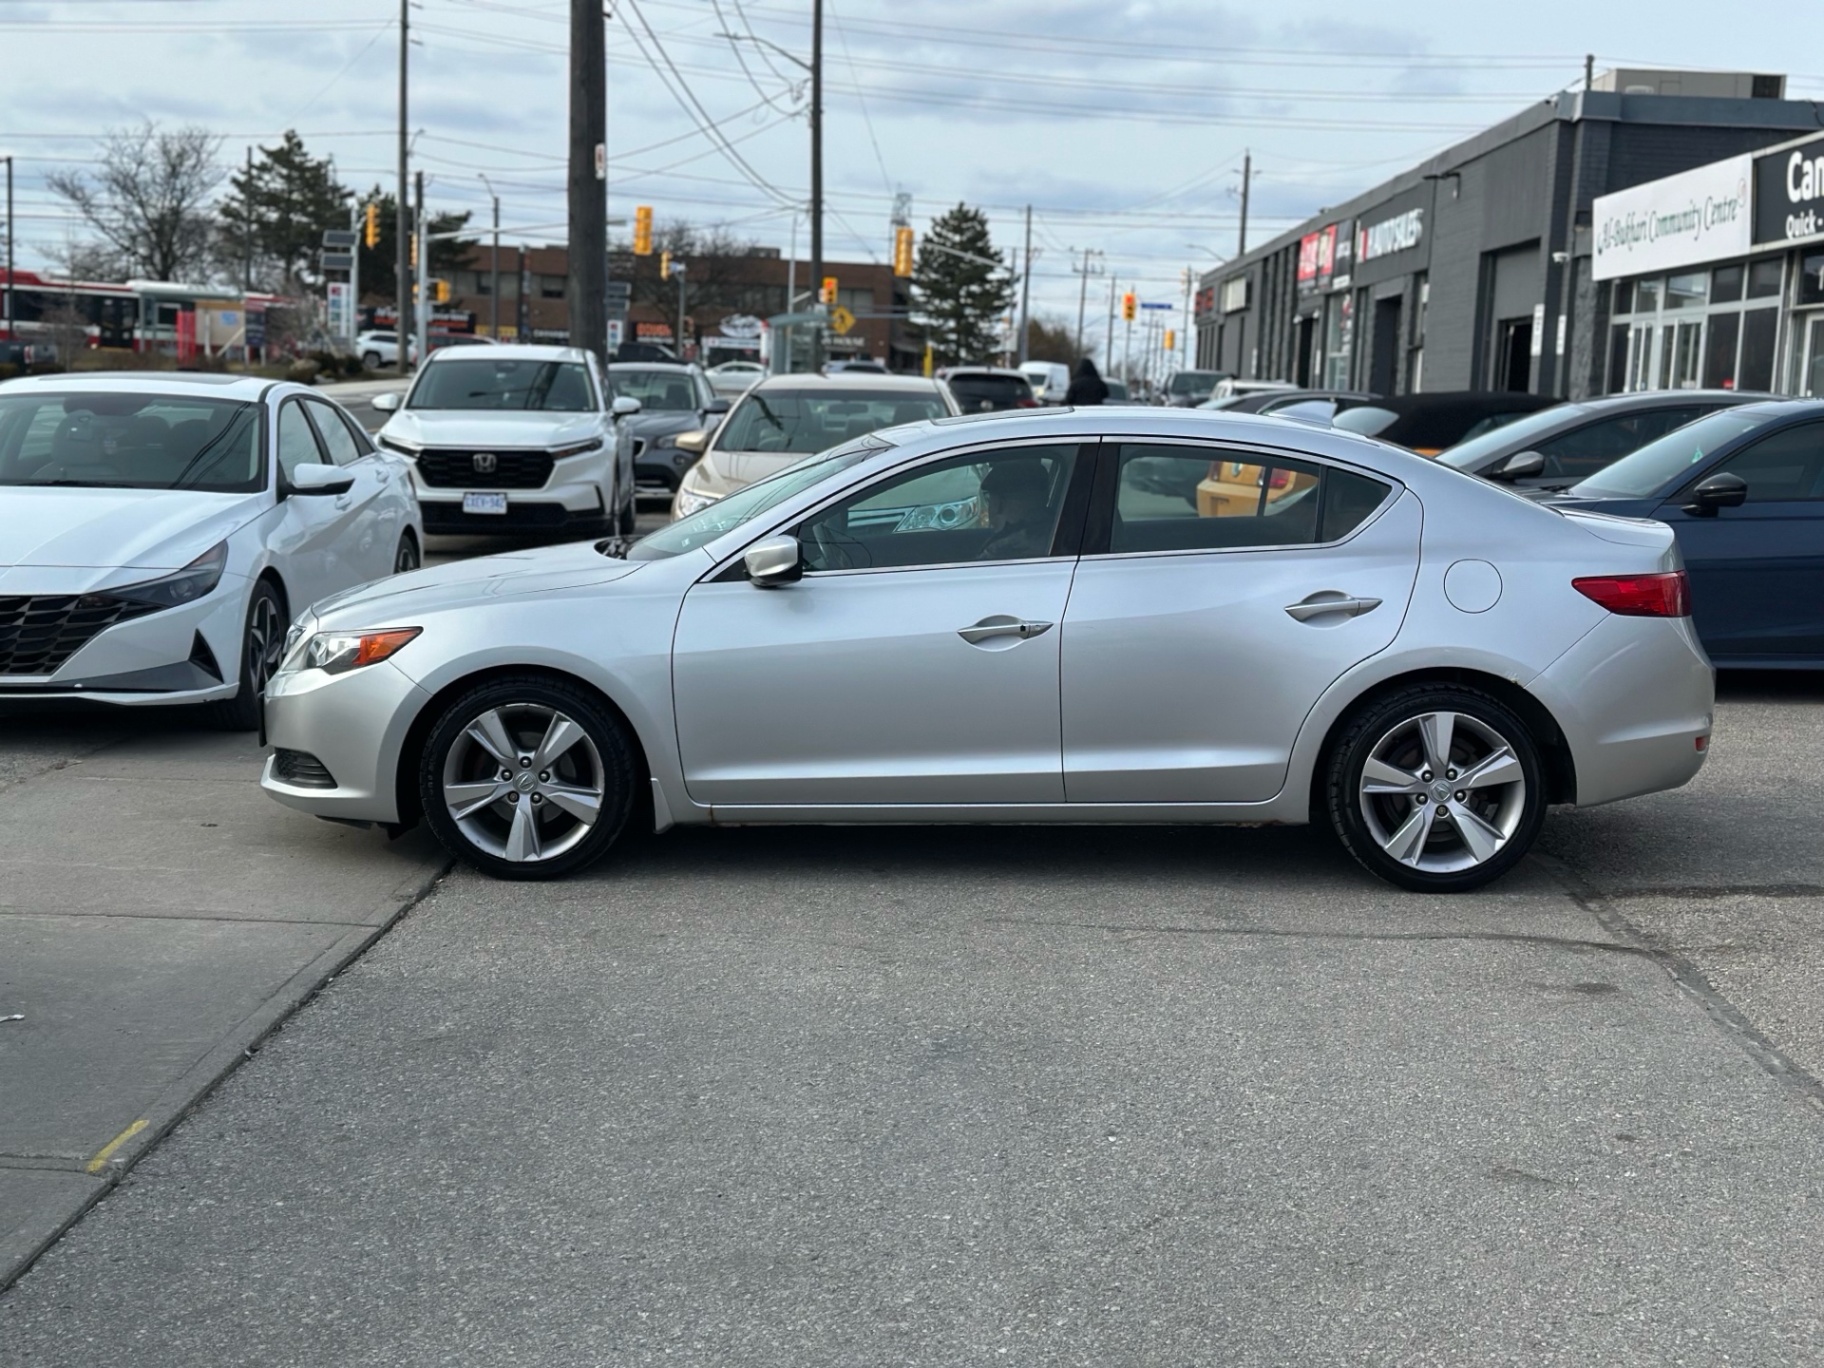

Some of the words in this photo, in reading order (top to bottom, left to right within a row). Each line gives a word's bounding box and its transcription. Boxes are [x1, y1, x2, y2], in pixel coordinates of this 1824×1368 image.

[1649, 200, 1701, 242] Community
[1705, 196, 1738, 231] Centre
[1786, 208, 1816, 240] Quick
